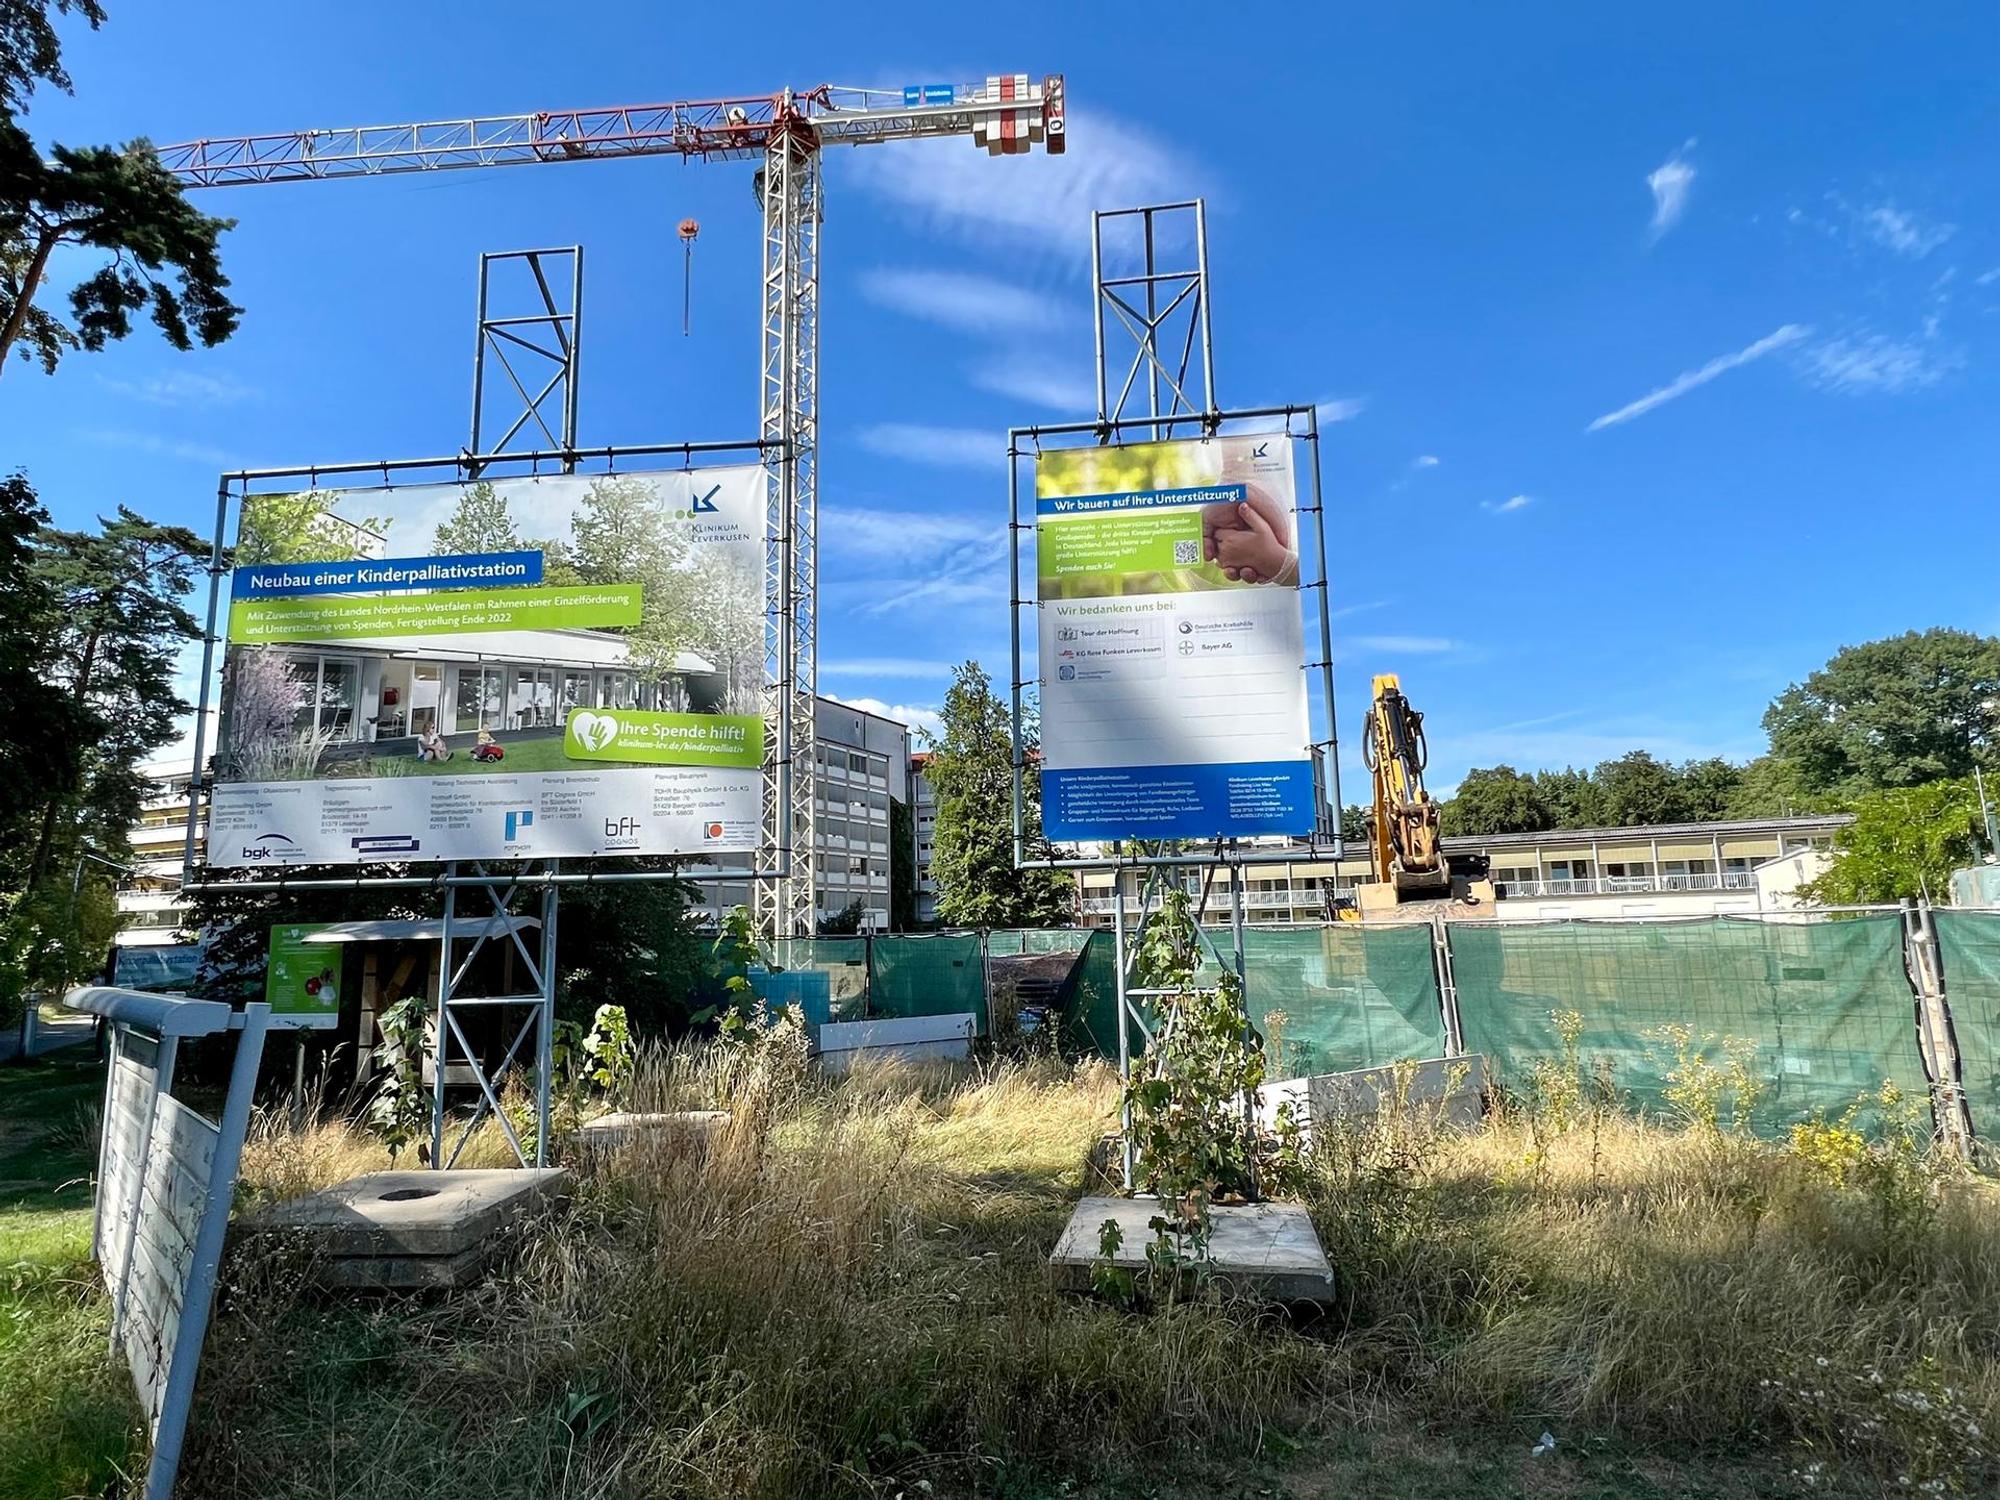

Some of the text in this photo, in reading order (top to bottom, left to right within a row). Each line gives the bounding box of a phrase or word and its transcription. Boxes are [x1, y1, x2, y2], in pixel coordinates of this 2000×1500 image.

[1055, 488, 1240, 512] Wir bauen auf Ihre Unterstützung!
[1056, 564, 1085, 573] Spenden
[1085, 563, 1102, 571] auch
[250, 562, 526, 590] Neubau einer Kinderpalliativstation
[246, 594, 630, 622] Mit Zuwendung des Landes Nordrhein-Westfalen im Rahmen einer Einzelförderung
[1057, 600, 1176, 615] Wir bedanken uns bei:
[246, 612, 512, 635] und Unterstützung von Spenden, Fertigstellung Ende 2022
[1108, 628, 1139, 636] Hoffnung
[1102, 648, 1125, 656] Funken
[1126, 646, 1161, 655] Leverkusen
[1201, 643, 1220, 651] Bayer
[620, 720, 746, 741] Ihre Spende hilft!
[617, 738, 744, 754] klinikum-lev.de/kinderpalliativ
[242, 846, 271, 860] bgk
